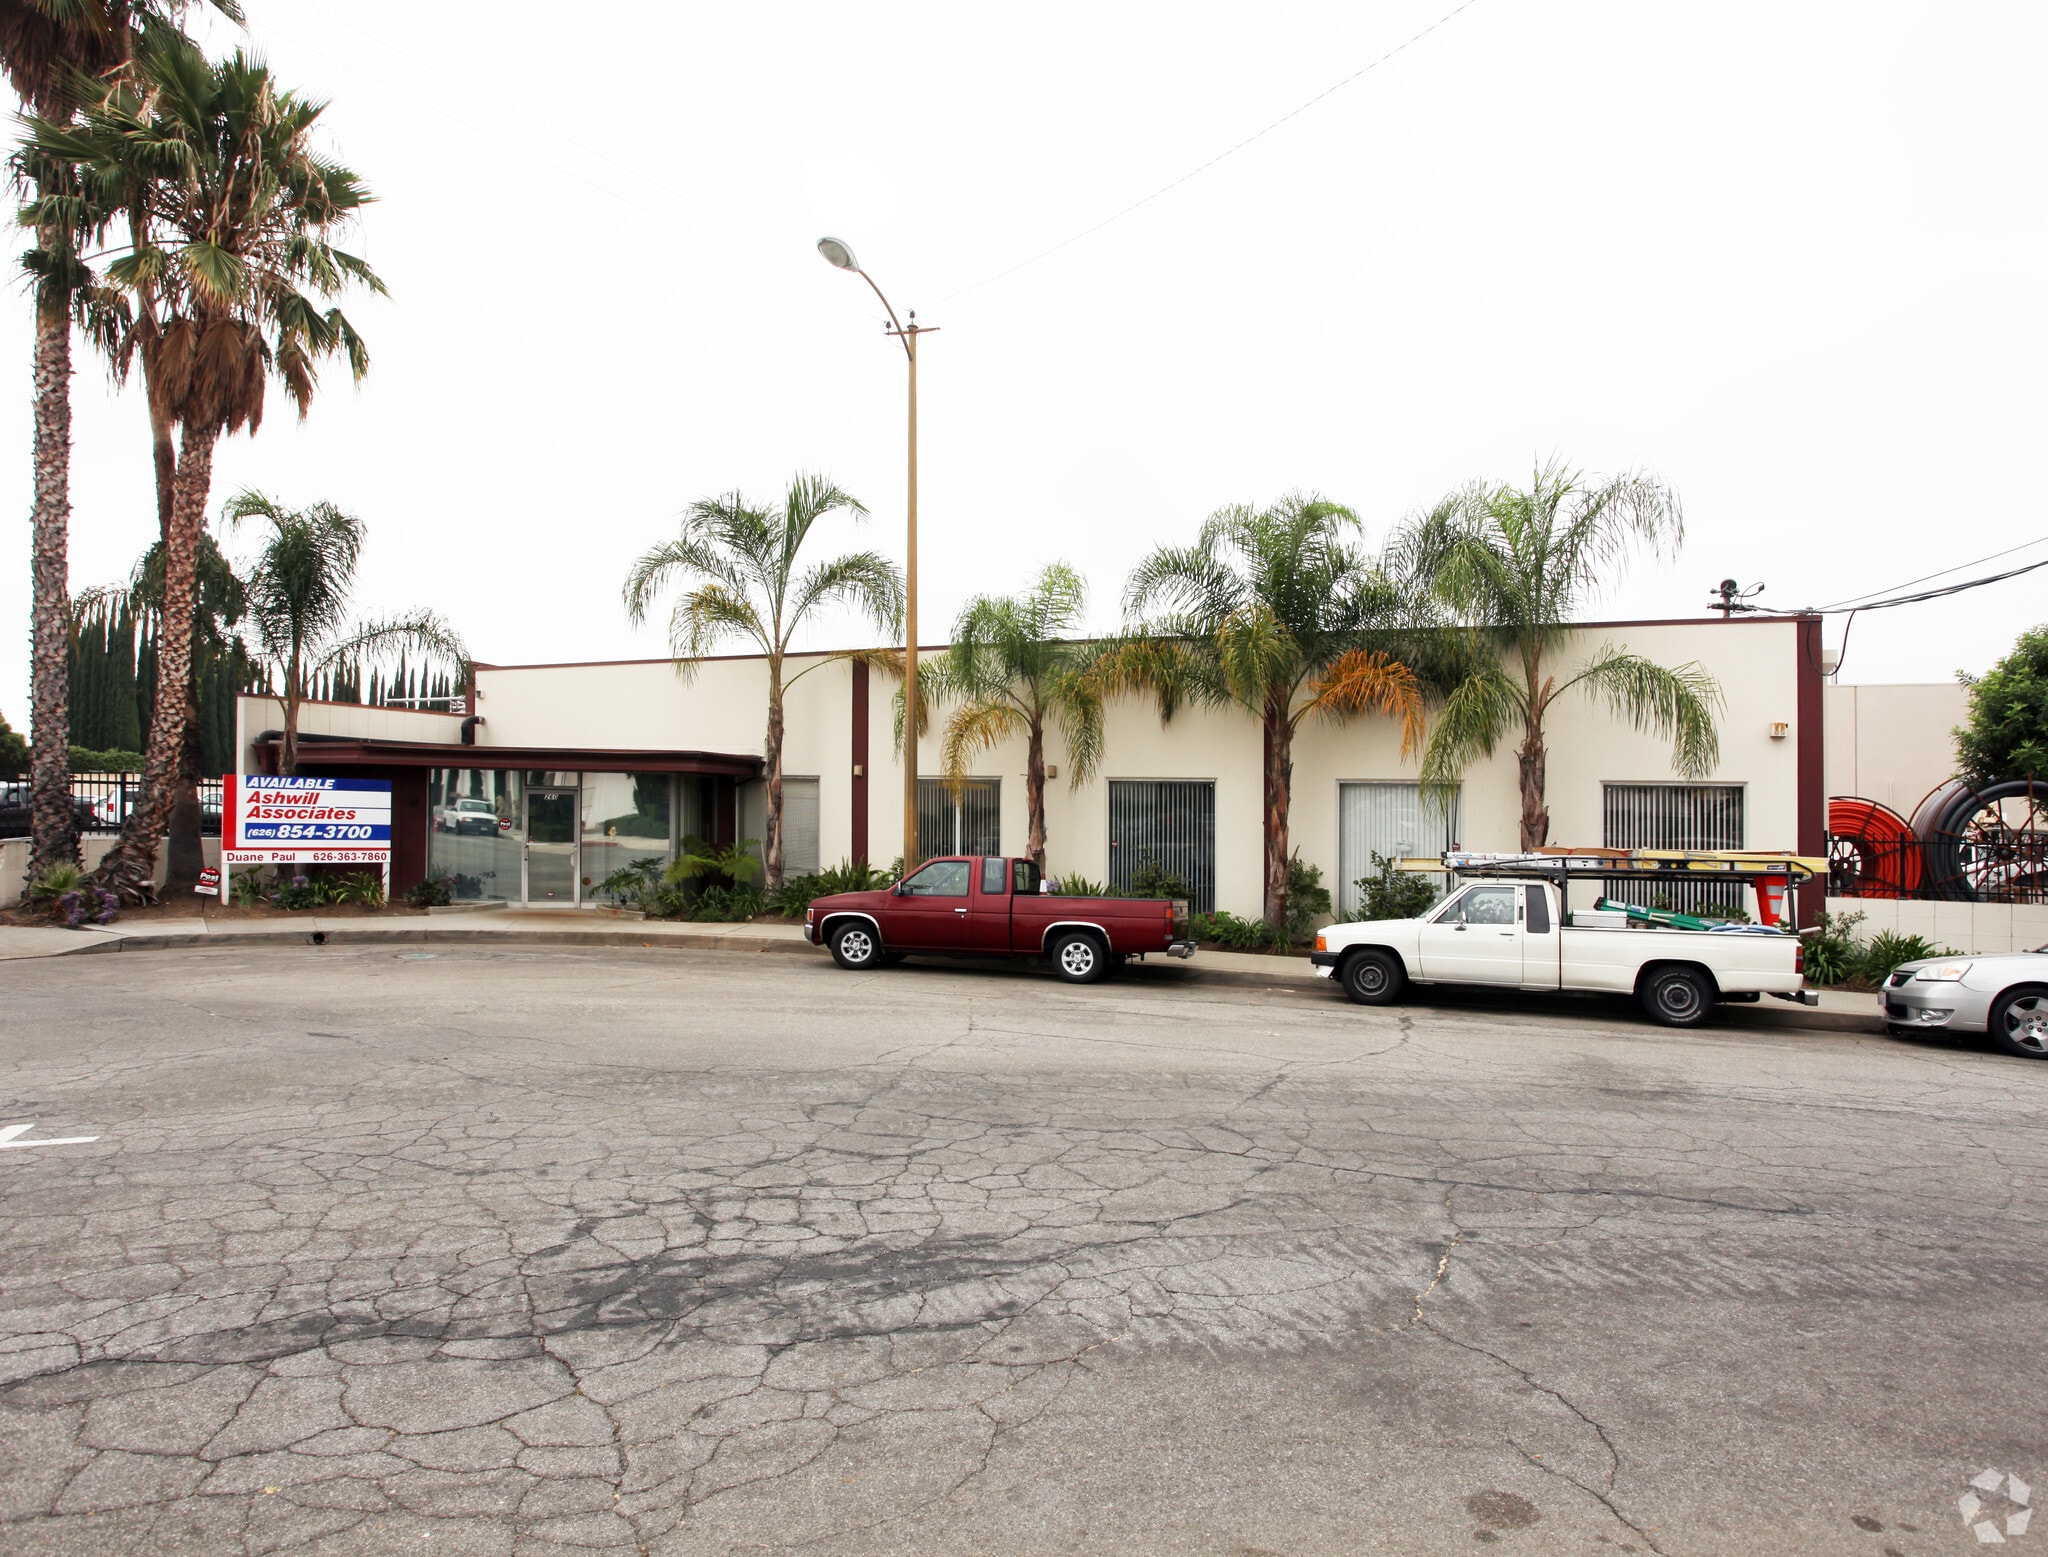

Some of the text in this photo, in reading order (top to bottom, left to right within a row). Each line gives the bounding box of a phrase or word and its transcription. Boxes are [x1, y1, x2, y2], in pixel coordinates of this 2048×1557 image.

[247, 777, 336, 790] AVAILABLE
[246, 791, 320, 805] Ashwill
[246, 805, 356, 820] Associates
[247, 824, 373, 839] (626) 854-3700
[226, 851, 387, 862] Duane Paul 626-363-7860
[200, 872, 219, 882] Post
